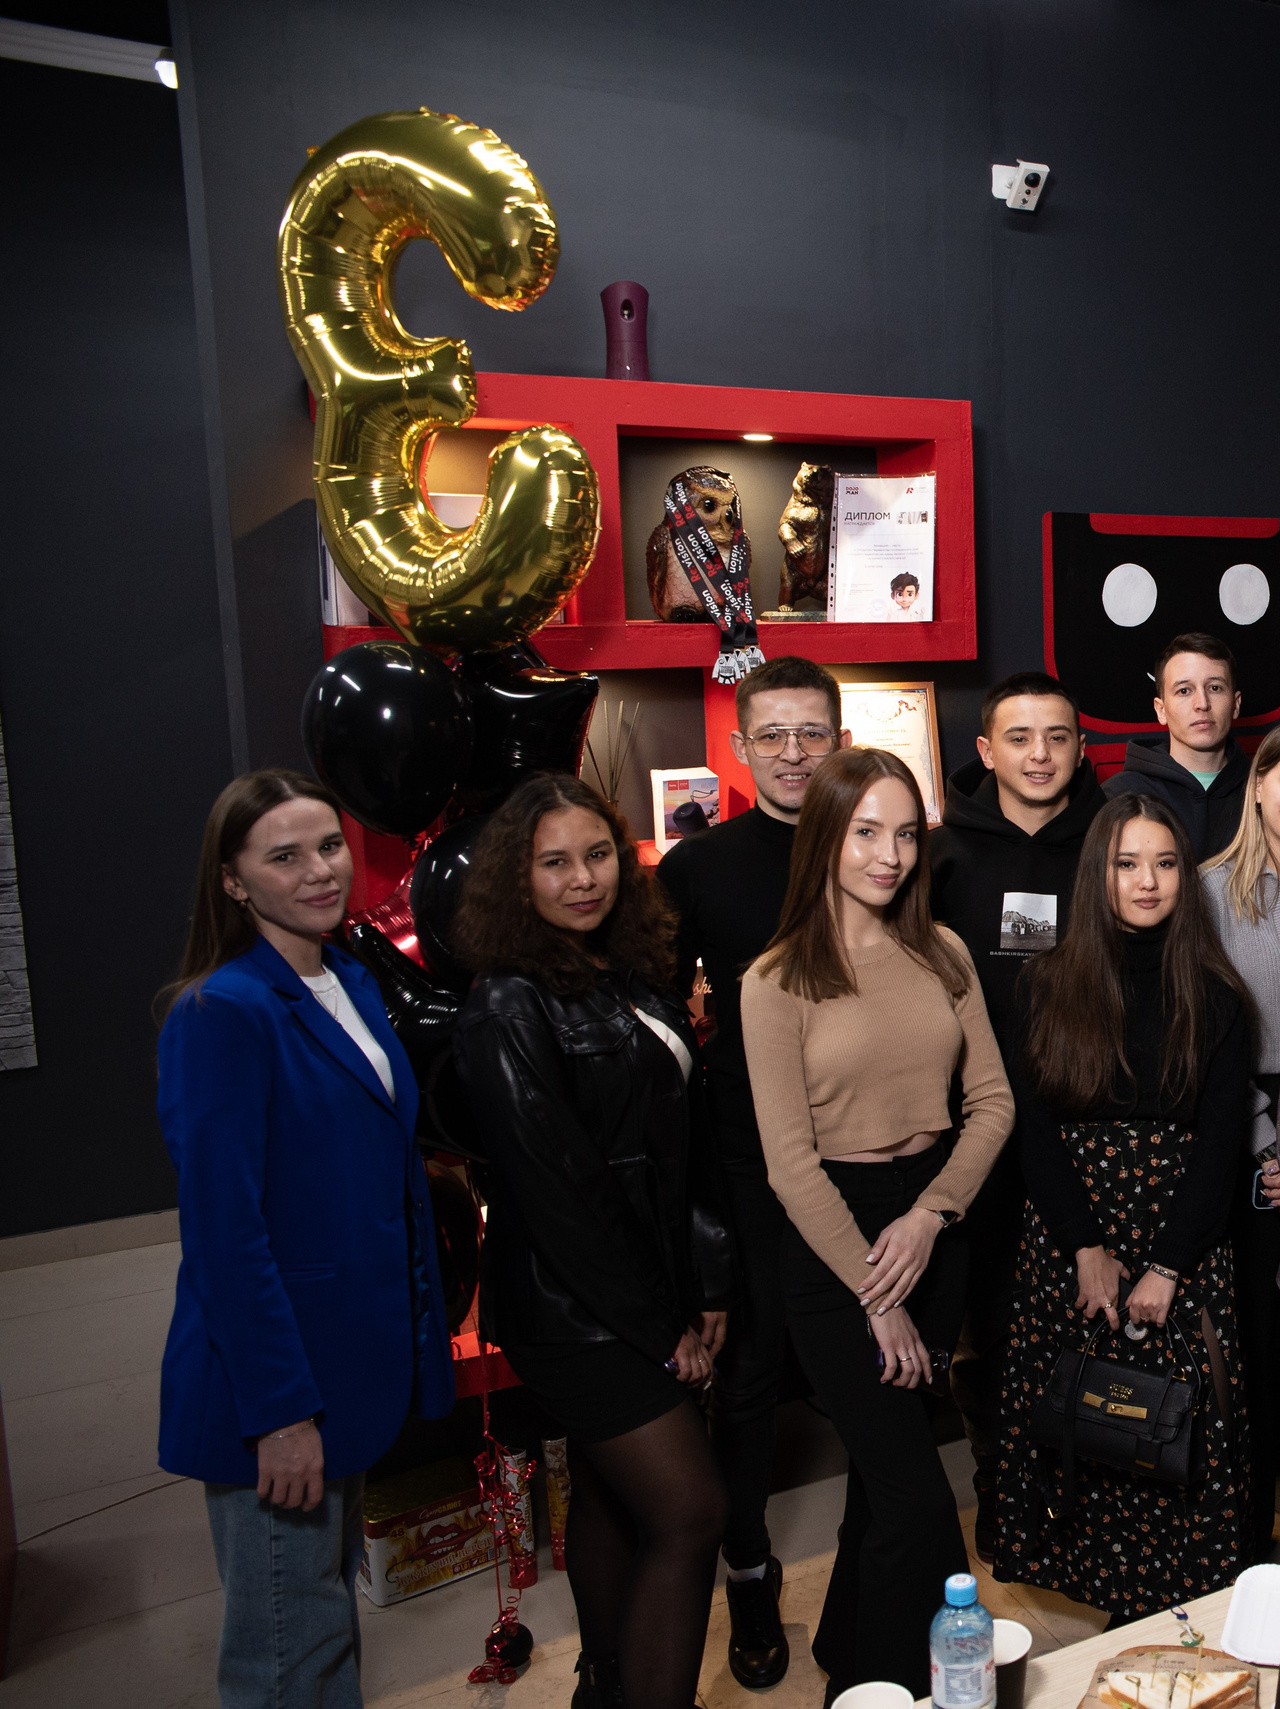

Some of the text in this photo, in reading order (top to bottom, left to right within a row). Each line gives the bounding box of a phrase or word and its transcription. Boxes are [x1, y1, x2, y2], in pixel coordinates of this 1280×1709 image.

[844, 511, 891, 521] ДИПЛОМ
[674, 537, 700, 583] Re:vision
[391, 1528, 405, 1538] 48
